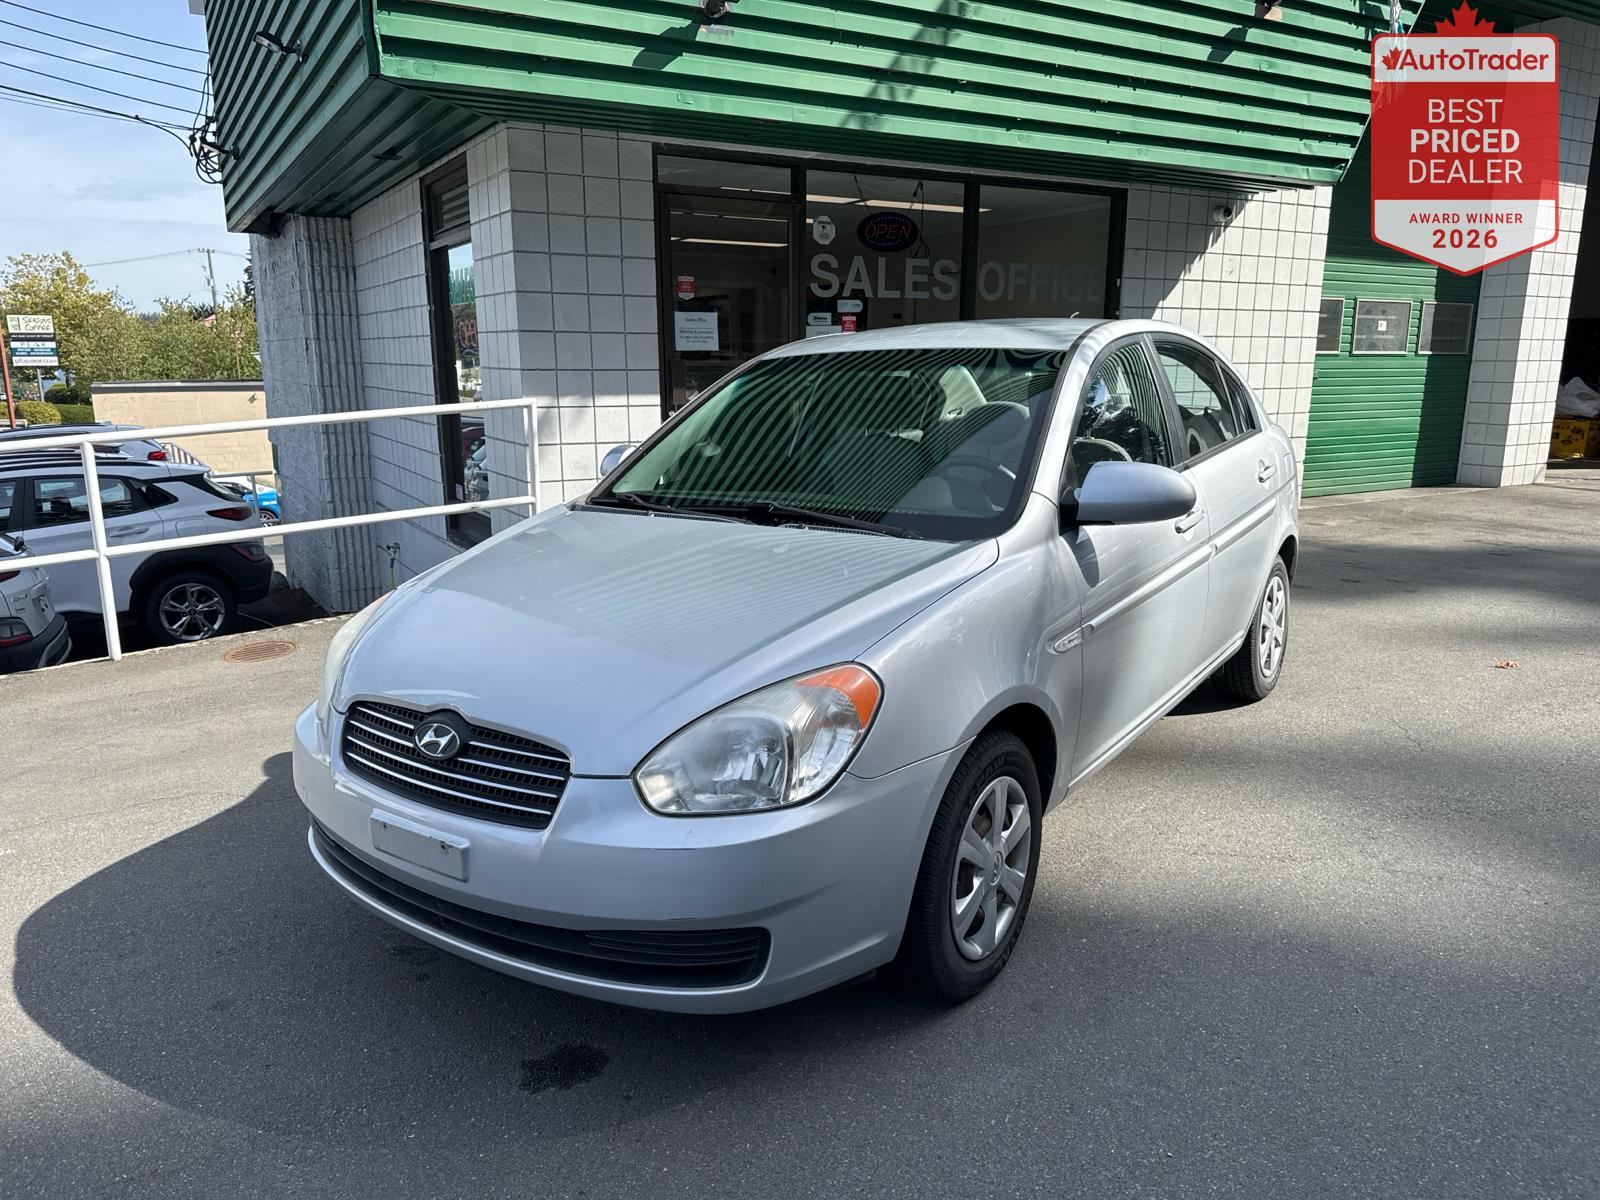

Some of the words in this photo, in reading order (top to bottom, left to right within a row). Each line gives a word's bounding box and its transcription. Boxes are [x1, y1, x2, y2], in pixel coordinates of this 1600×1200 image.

[864, 223, 912, 240] OPEN
[809, 253, 959, 300] SALES
[978, 260, 1105, 303] OFFICE
